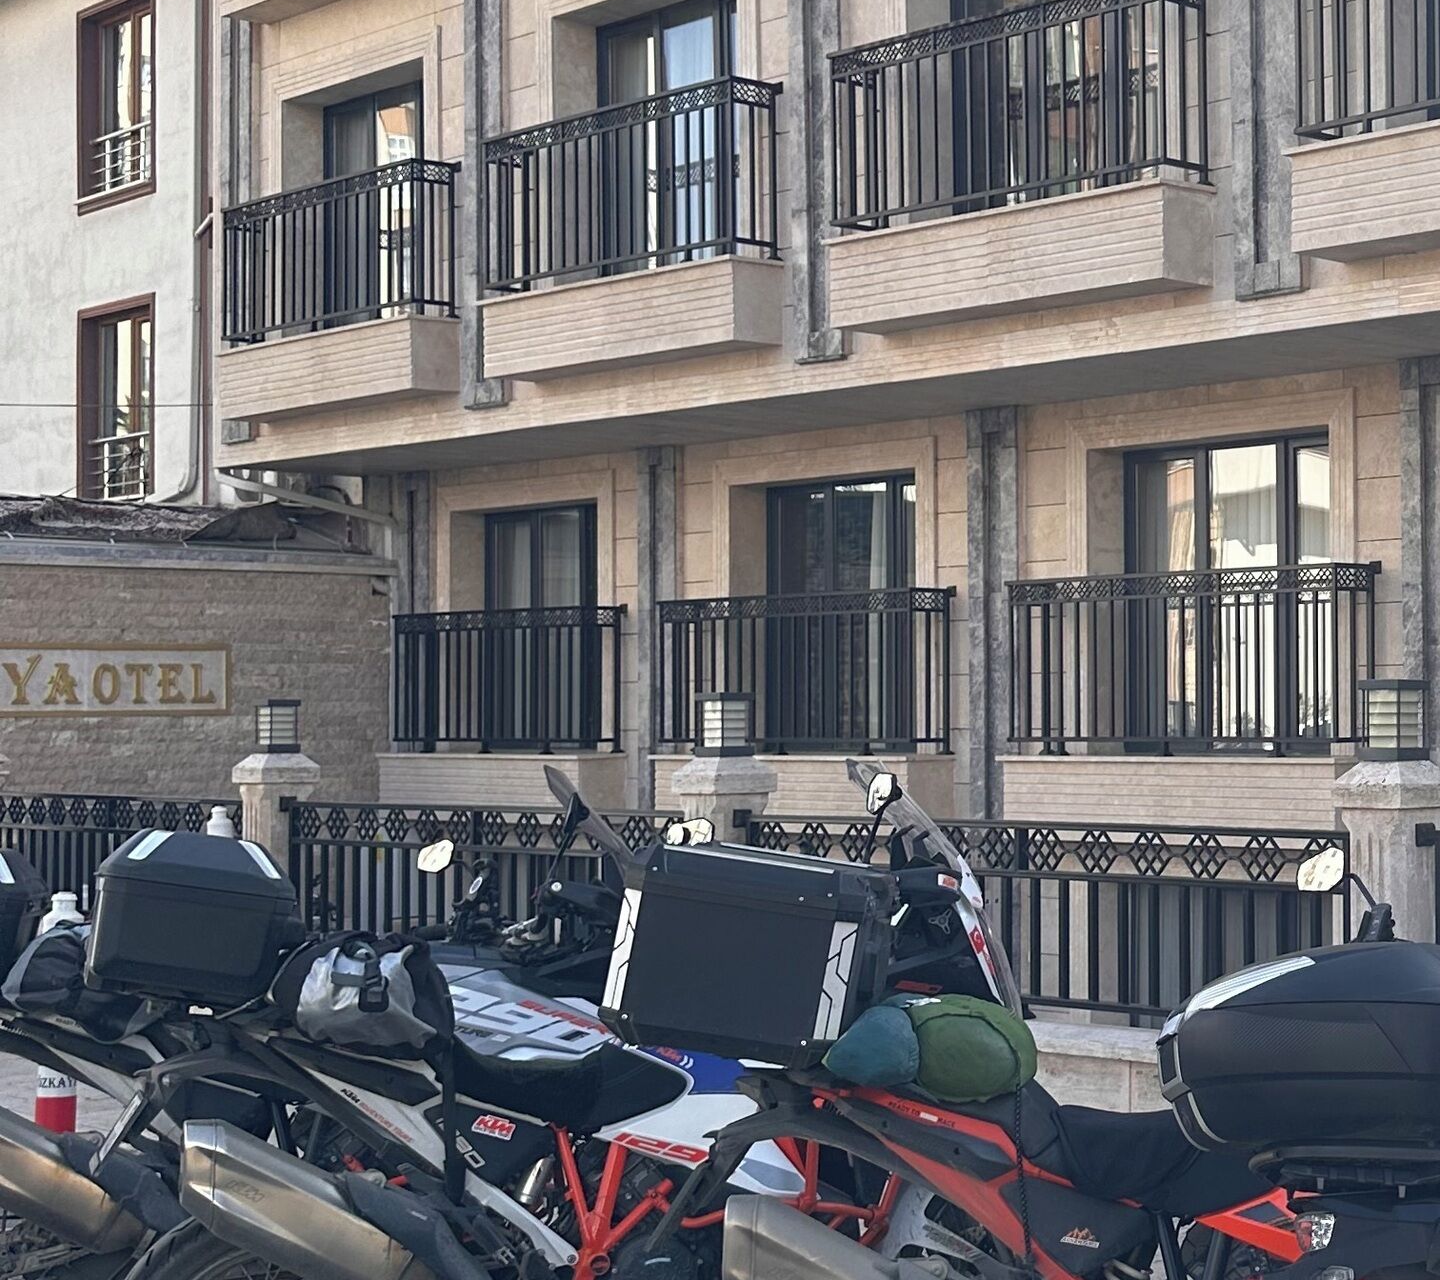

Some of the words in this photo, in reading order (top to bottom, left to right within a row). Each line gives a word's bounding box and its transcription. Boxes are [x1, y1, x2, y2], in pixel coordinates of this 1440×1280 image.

[2, 654, 82, 705] YA
[92, 663, 216, 705] OTEL
[517, 999, 609, 1035] SUPER
[476, 1117, 515, 1136] KTM
